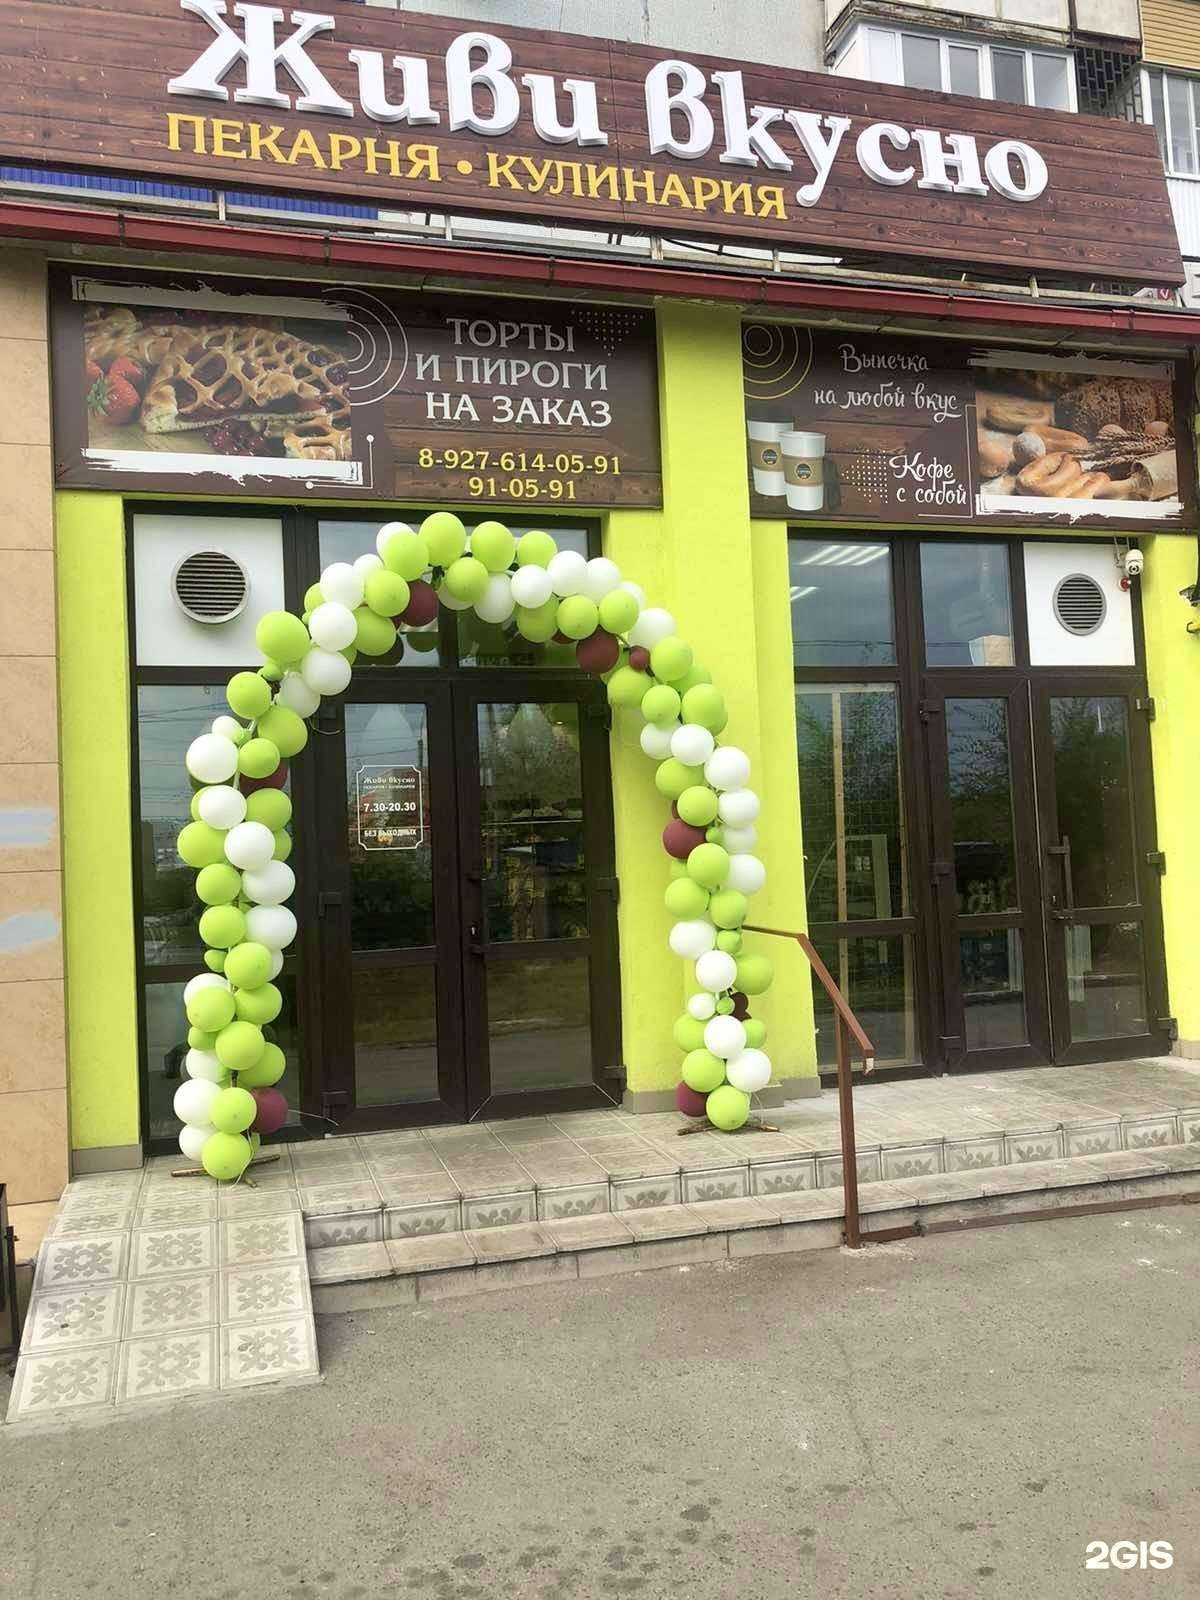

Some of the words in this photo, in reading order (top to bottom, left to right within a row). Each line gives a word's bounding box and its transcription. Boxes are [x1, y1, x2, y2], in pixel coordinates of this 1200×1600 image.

[167, 0, 608, 147] Живи
[645, 59, 1049, 207] вкусно
[166, 112, 442, 182] ПЕКАРНЯ
[486, 151, 788, 220] КУЛИНАРИЯ
[446, 317, 575, 353] ТОРТЫ
[415, 353, 441, 382] И
[455, 355, 608, 391] ПИРОГИ
[838, 343, 929, 373] Выпечка
[425, 391, 480, 421] НА
[492, 394, 613, 427] ЗАКАЗ
[814, 388, 836, 404] на
[840, 382, 905, 409] любой
[911, 382, 962, 423] вкус
[418, 448, 621, 475] 8-927-614-05-91
[888, 451, 954, 492] Кофе
[468, 476, 576, 499] 91-05-91
[896, 487, 906, 502] с
[915, 479, 966, 505] собой
[363, 802, 416, 812] 7.30-20.30
